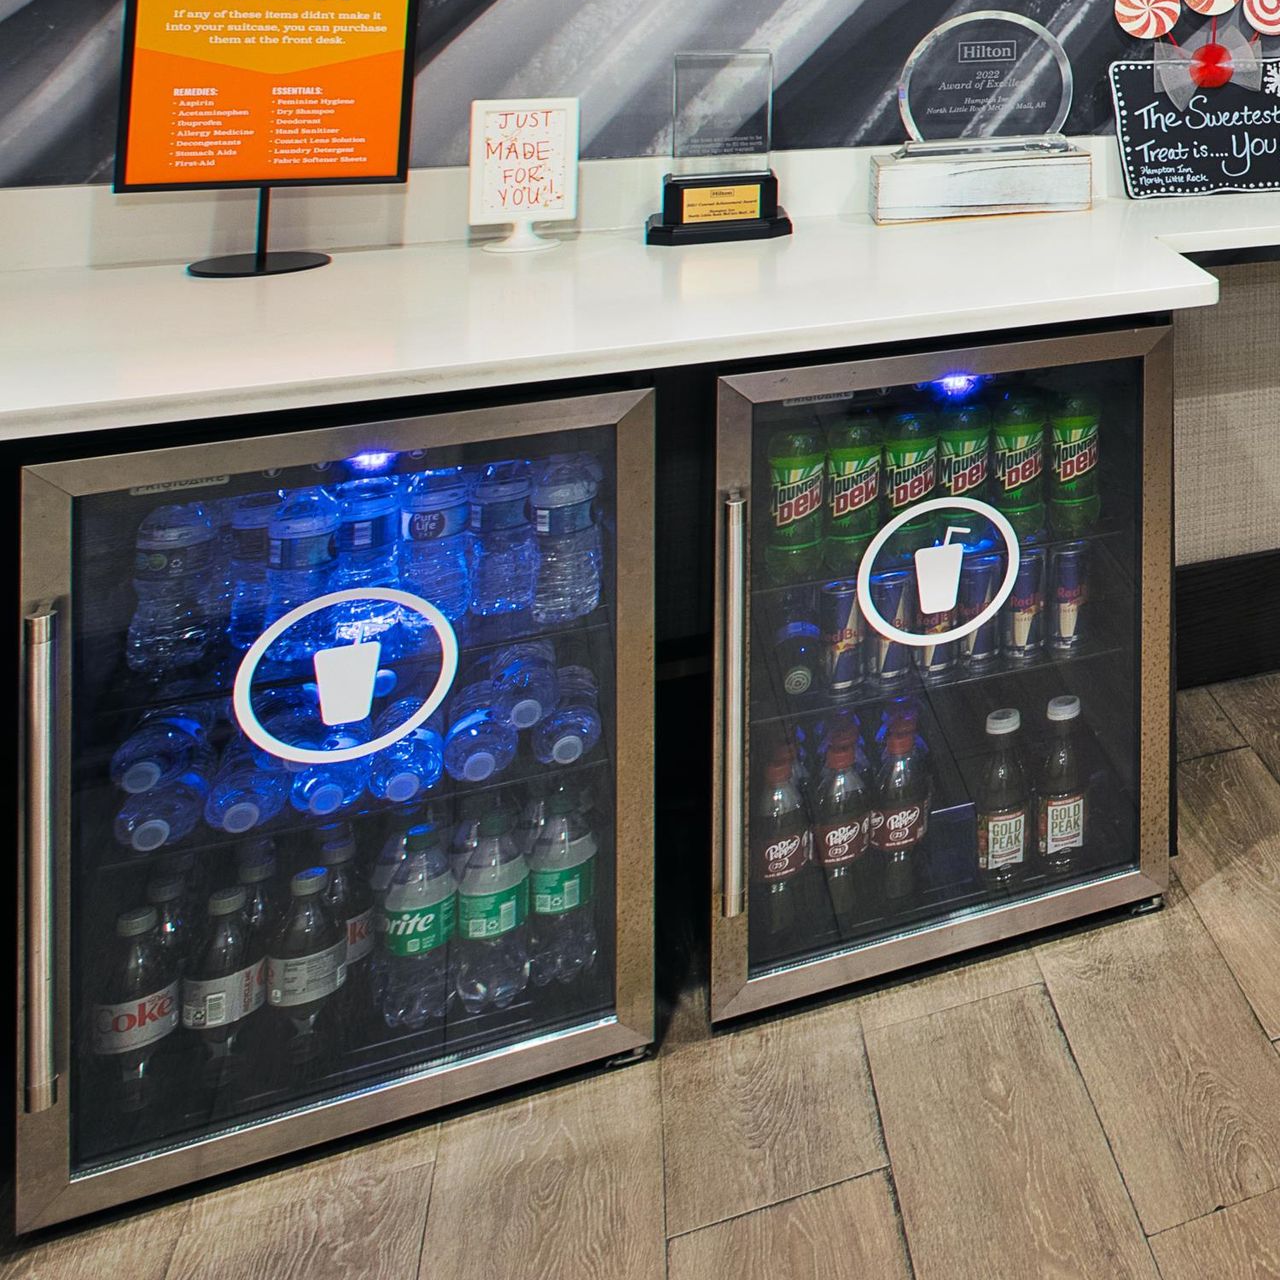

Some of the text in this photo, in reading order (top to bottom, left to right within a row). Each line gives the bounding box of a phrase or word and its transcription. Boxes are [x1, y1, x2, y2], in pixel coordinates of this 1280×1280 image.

[174, 10, 185, 19] If
[187, 11, 210, 21] any
[213, 10, 226, 20] of
[228, 10, 262, 20] these
[265, 11, 299, 20] items
[338, 11, 371, 21] make
[373, 12, 382, 21] it
[166, 22, 388, 34] into your suitcase, you can purchase
[209, 35, 241, 45] them
[244, 36, 257, 45] at
[259, 35, 279, 45] the
[282, 35, 313, 45] front
[963, 46, 1012, 59] Hilton
[975, 70, 1001, 80] 2022
[938, 81, 972, 91] Award
[974, 80, 986, 91] of
[498, 110, 553, 130] JUST
[1134, 102, 1182, 131] The
[485, 140, 551, 161] MADE
[1136, 141, 1189, 164] Treat
[503, 165, 541, 184] FOR
[1139, 165, 1194, 176] Hampton Inn
[1139, 175, 1165, 185] North
[1185, 174, 1210, 184] Rock
[1051, 804, 1082, 821] GOLD
[1051, 817, 1082, 833] PEAK
